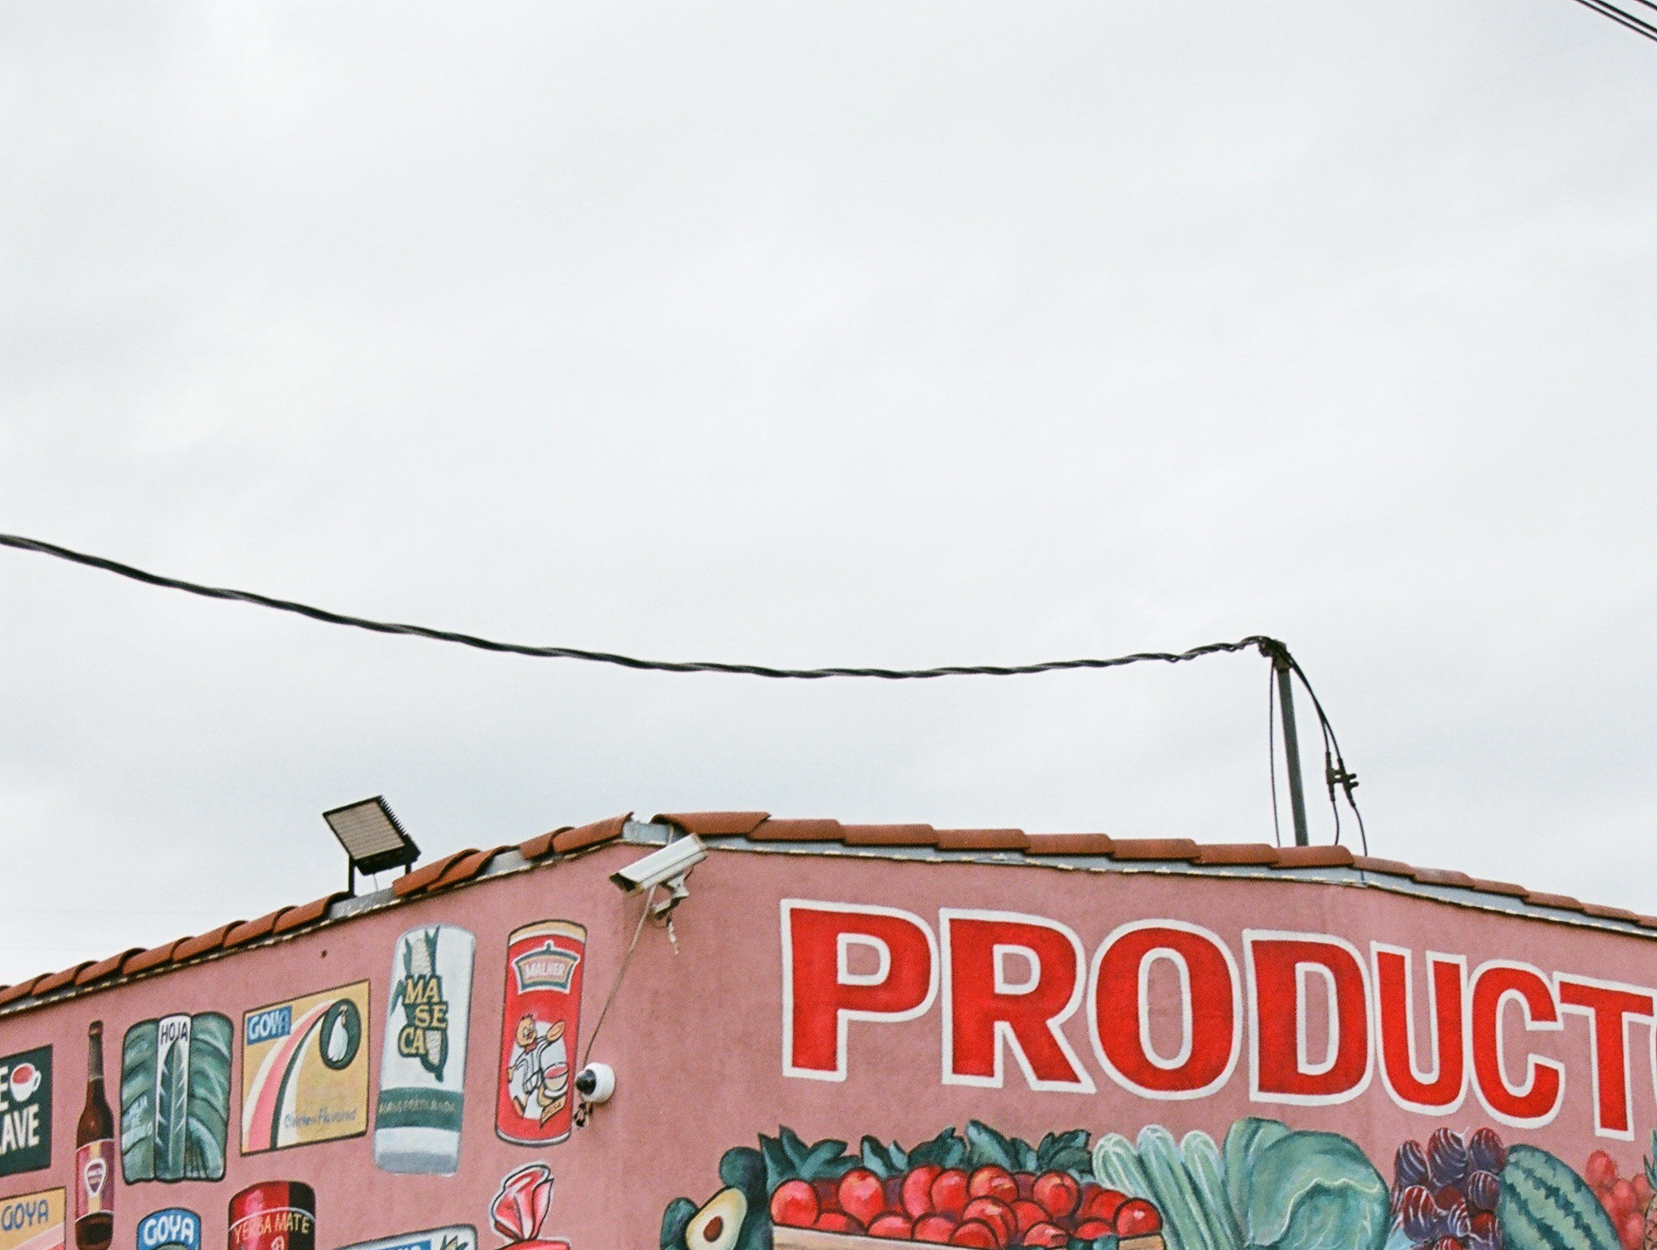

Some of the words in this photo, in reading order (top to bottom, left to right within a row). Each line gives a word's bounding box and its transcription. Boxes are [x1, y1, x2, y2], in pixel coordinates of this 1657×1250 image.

[160, 1021, 189, 1046] HOJA
[249, 1008, 290, 1041] GOYA
[780, 897, 1657, 1142] PRODUCT
[1, 1199, 49, 1231] GOYA
[143, 1214, 195, 1246] GOYA
[234, 1214, 272, 1244] YERBA
[274, 1211, 310, 1234] MATE
